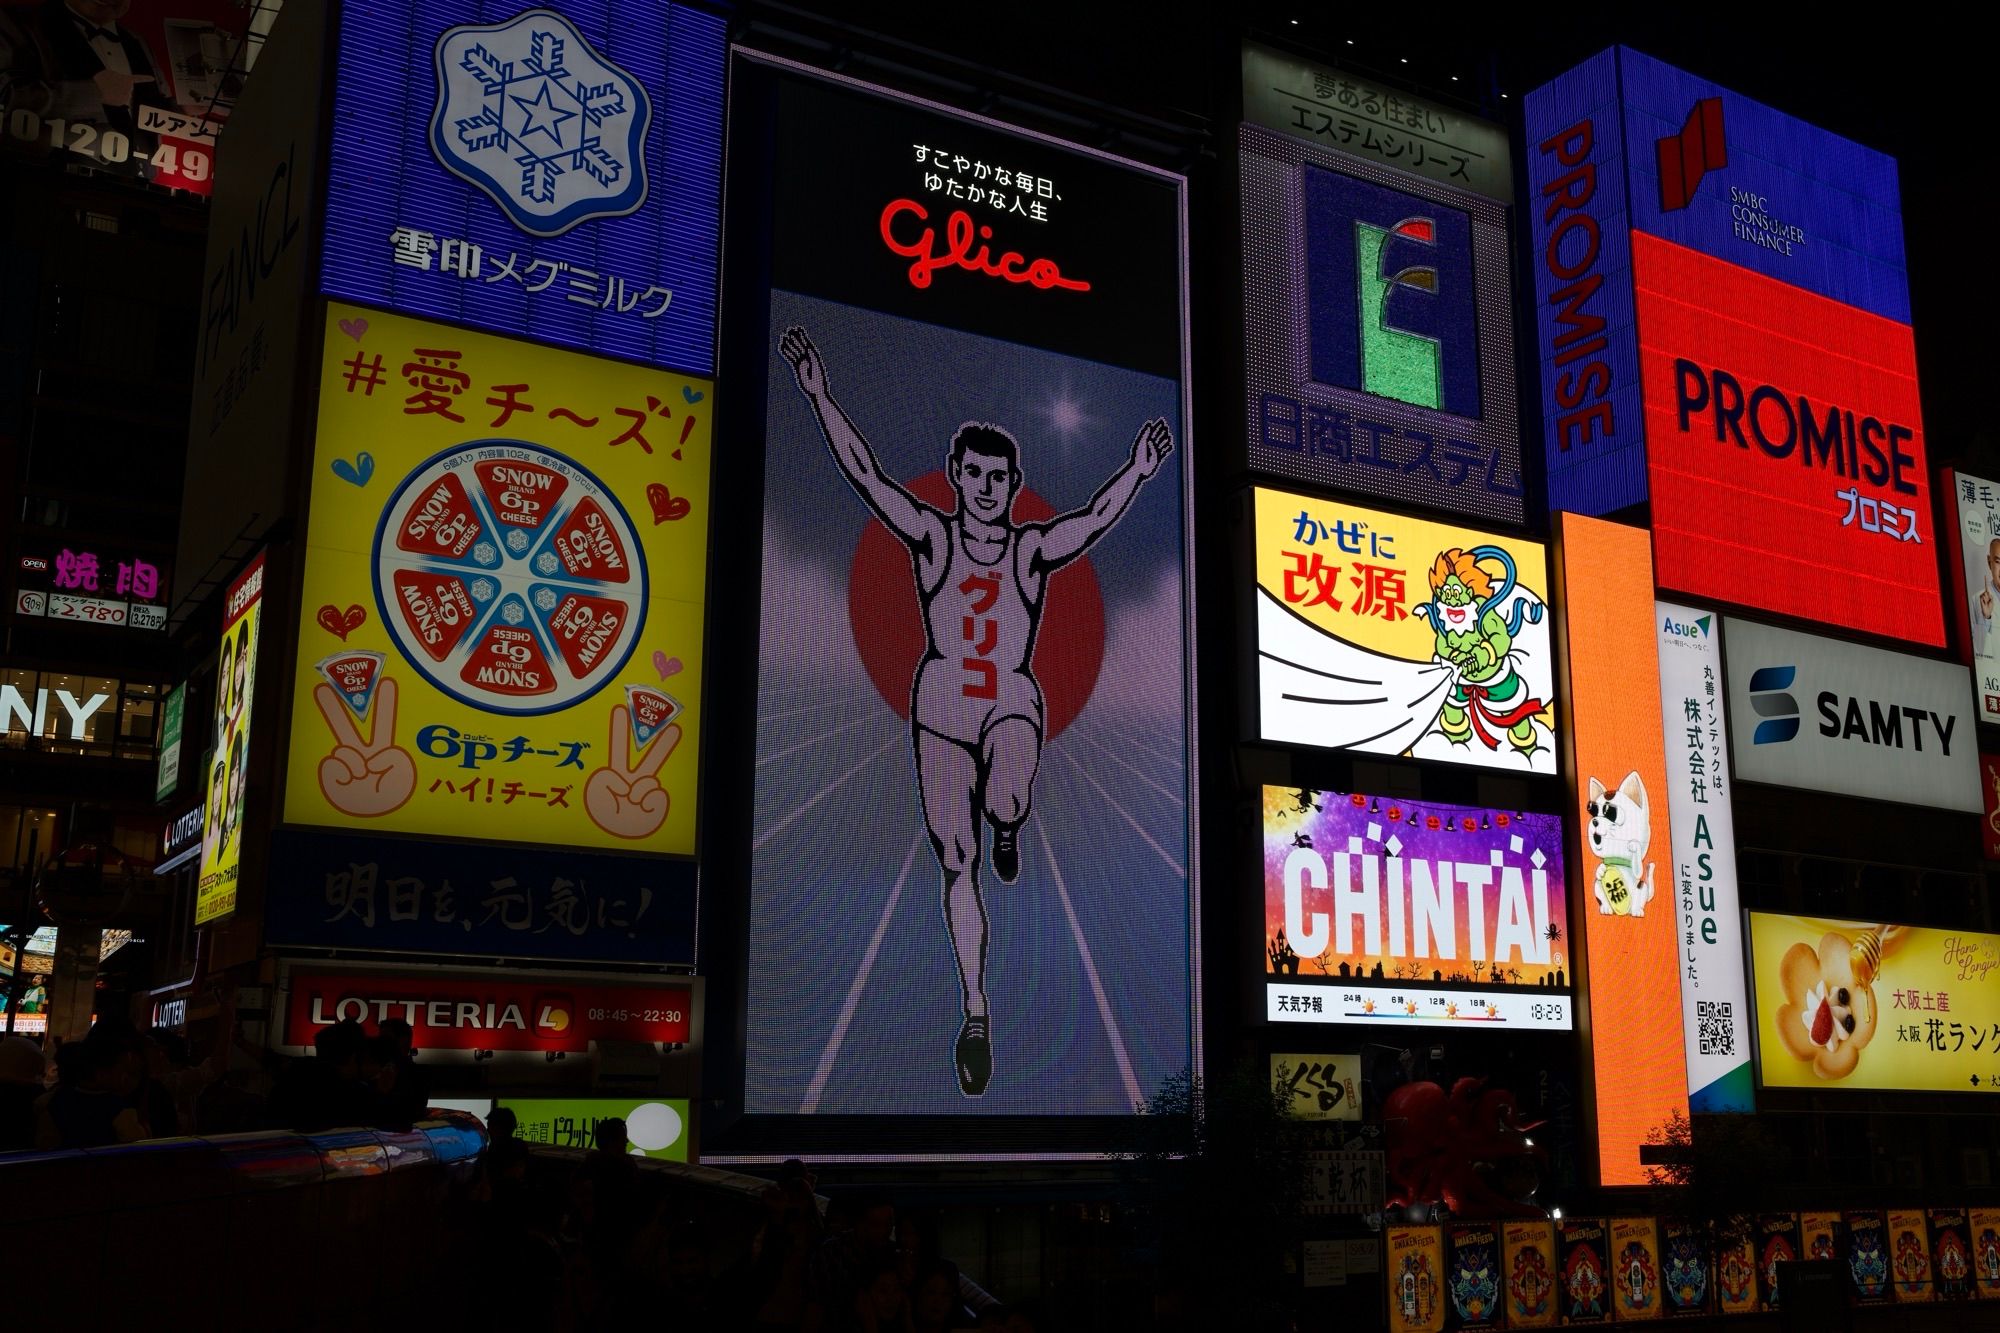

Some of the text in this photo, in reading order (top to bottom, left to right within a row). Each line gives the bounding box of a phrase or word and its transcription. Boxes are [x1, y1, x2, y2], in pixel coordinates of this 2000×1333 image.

[1314, 72, 1446, 134] 夢ある住まい
[9, 108, 215, 182] 0120-49
[1292, 106, 1471, 183] エステムシリーズ
[913, 144, 1062, 202] すこやかな毎日、
[924, 172, 1049, 222] ゆたかな人生
[1731, 186, 1768, 213] SMBC
[1732, 204, 1806, 246] CONSUMER
[1734, 221, 1793, 256] FINANCE
[202, 139, 300, 378] FANCL
[880, 198, 1092, 292] Glico
[390, 226, 673, 319] 雪印メグミルク
[1540, 119, 1616, 453] PROMISE
[1262, 391, 1526, 498] 日商エステム
[1673, 357, 1918, 496] PROMISE
[442, 454, 475, 472] 6個入り
[491, 465, 555, 491] SNOW
[508, 484, 537, 495] BRAND
[407, 482, 454, 542] SNOW
[431, 508, 451, 532] BRAND
[500, 511, 539, 525] CHEESE
[1836, 486, 1923, 544] プロミス
[452, 522, 480, 556] CHEESE
[584, 511, 624, 570] SNOW
[586, 532, 602, 559] BRAND
[1293, 510, 1396, 560] かぜに
[22, 559, 47, 569] OPEN
[55, 548, 160, 599] 焼肉
[556, 537, 580, 575] CHEESE
[24, 596, 43, 610] 90分
[52, 595, 105, 607] スタンダード
[449, 579, 474, 618] CHEESE
[1281, 550, 1409, 622] 改源
[400, 584, 444, 645] SNOW
[425, 595, 443, 624] BRAND
[551, 596, 577, 630] CHEESE
[1664, 617, 1698, 638] Asue
[492, 628, 532, 643] CHEESE
[577, 610, 619, 669] SNOW
[579, 619, 598, 644] BRAND
[959, 571, 1003, 701] グリコ
[336, 660, 369, 674] SNOW
[476, 665, 541, 690] SNOW
[495, 659, 524, 670] BRAND
[1984, 676, 2000, 692] AG
[638, 694, 669, 712] SNOW
[1703, 664, 1723, 797] 丸善インテックは、
[1817, 691, 1956, 757] SAMTY
[171, 802, 205, 847] LOTTERIA
[1684, 697, 1718, 945] 株式会社 Asue
[1283, 822, 1553, 966] CHINTAI
[1681, 863, 1700, 989] に変わりました。
[1943, 937, 1979, 966] Hana
[158, 999, 187, 1028] LOTTERI
[312, 997, 526, 1030] LOTTERIA
[1277, 995, 1323, 1013] 天気予報
[1343, 994, 1486, 1007] 24時 6時 12時 18時
[1893, 989, 1950, 1013] 大阪土産
[1897, 1025, 1921, 1043] 大阪
